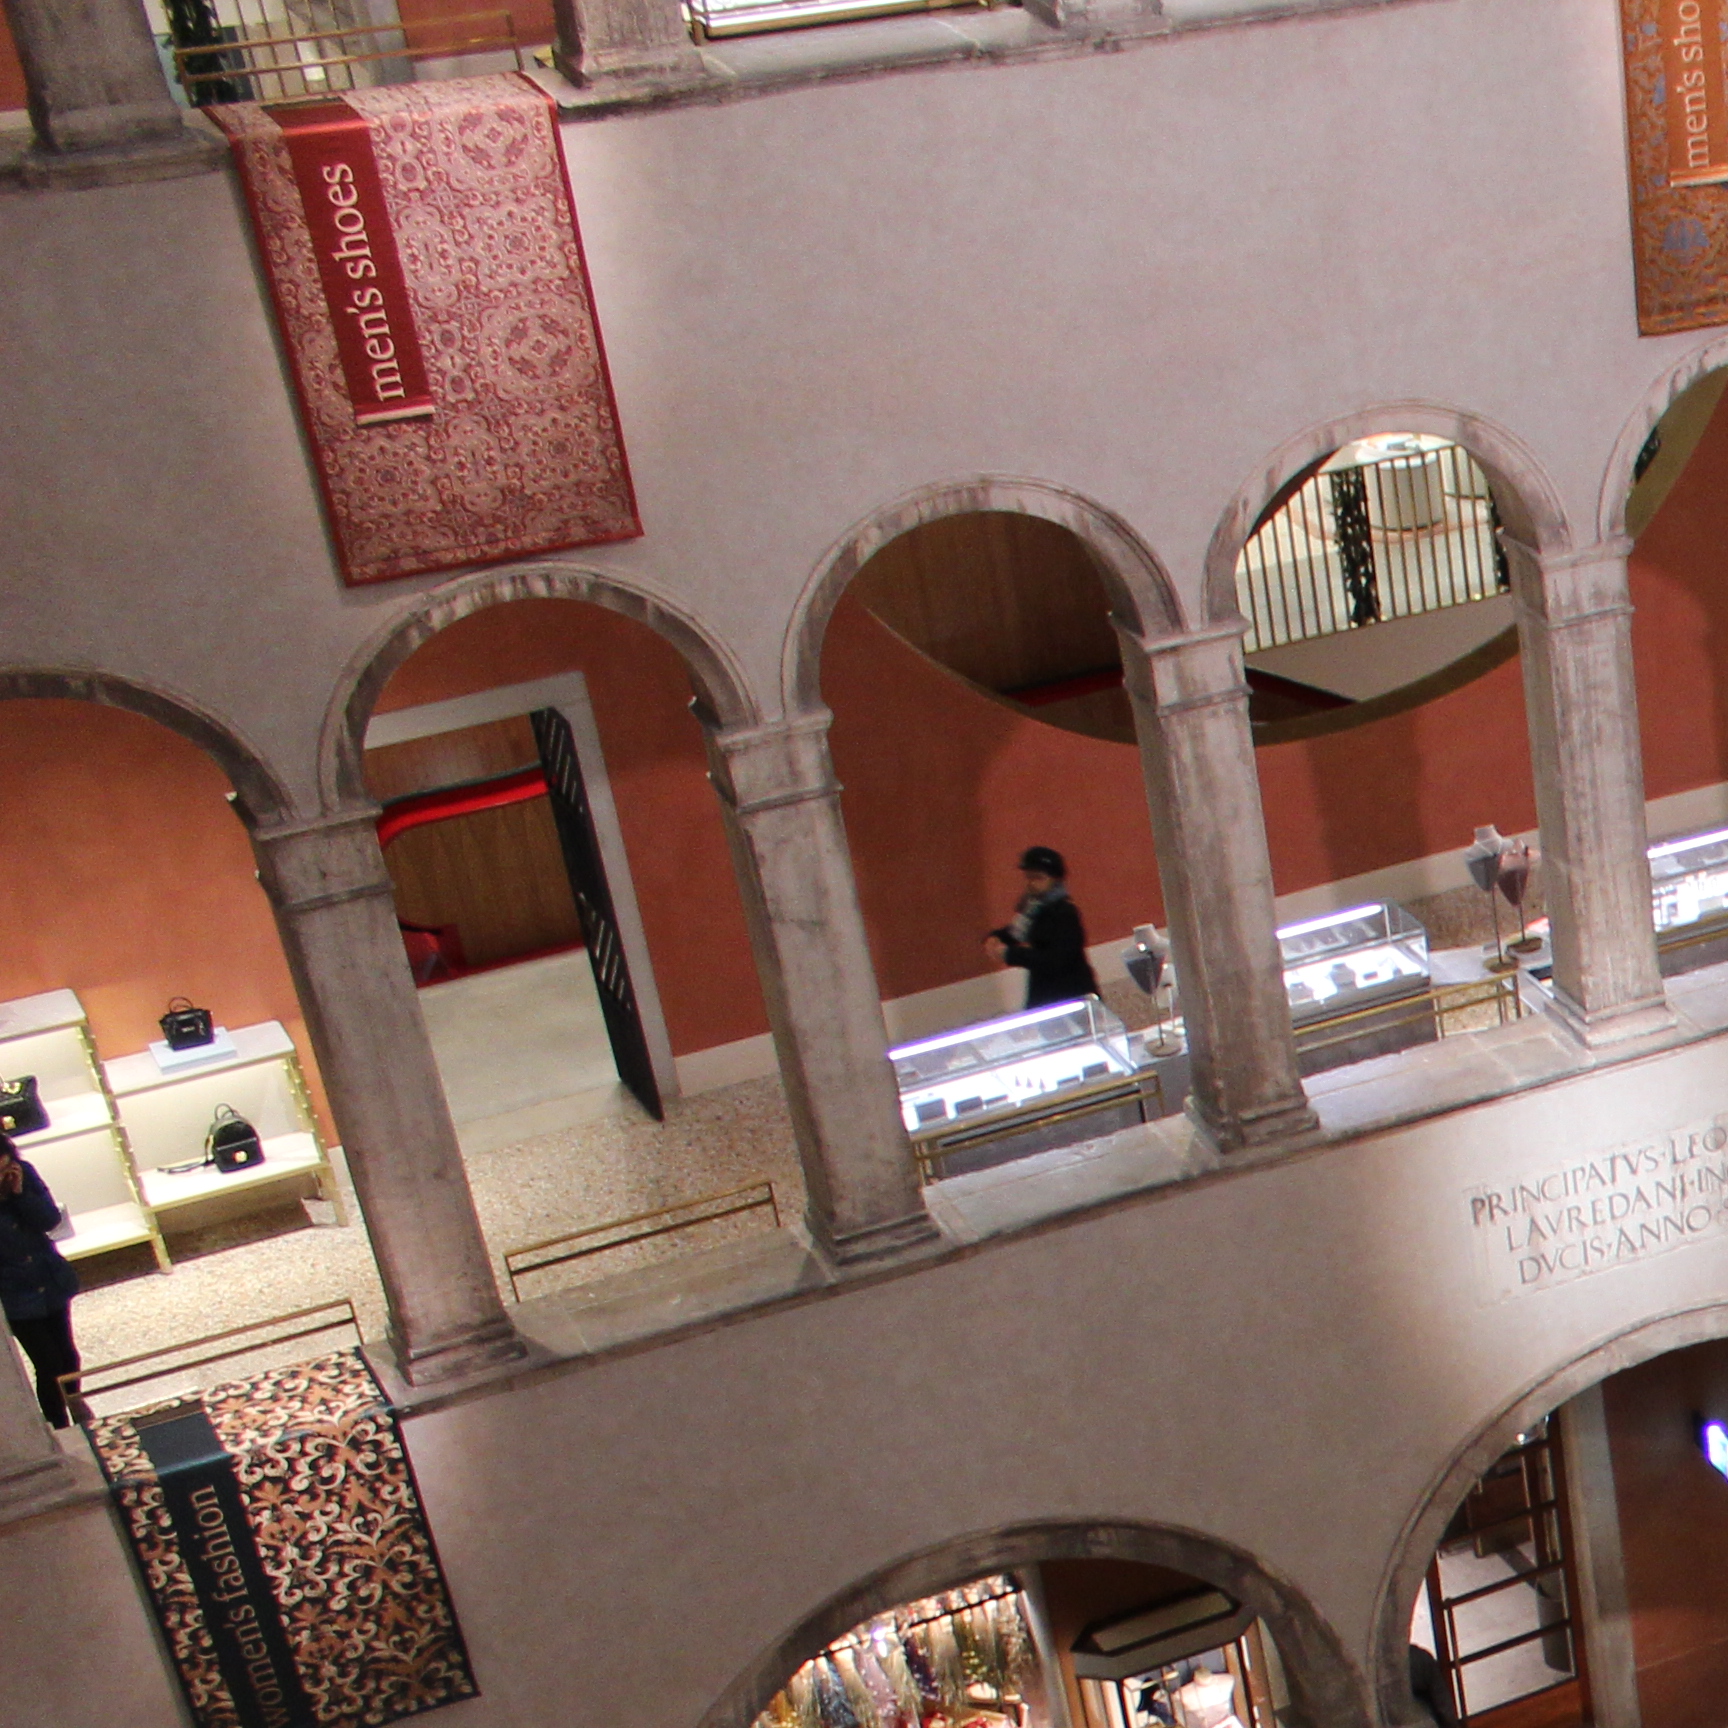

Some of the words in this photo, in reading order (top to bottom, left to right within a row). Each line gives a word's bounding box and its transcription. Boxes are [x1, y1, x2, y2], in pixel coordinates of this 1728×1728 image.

[1676, 69, 1710, 168] men's
[322, 161, 377, 280] shoes
[347, 291, 405, 402] men's
[188, 1483, 250, 1601] fashion
